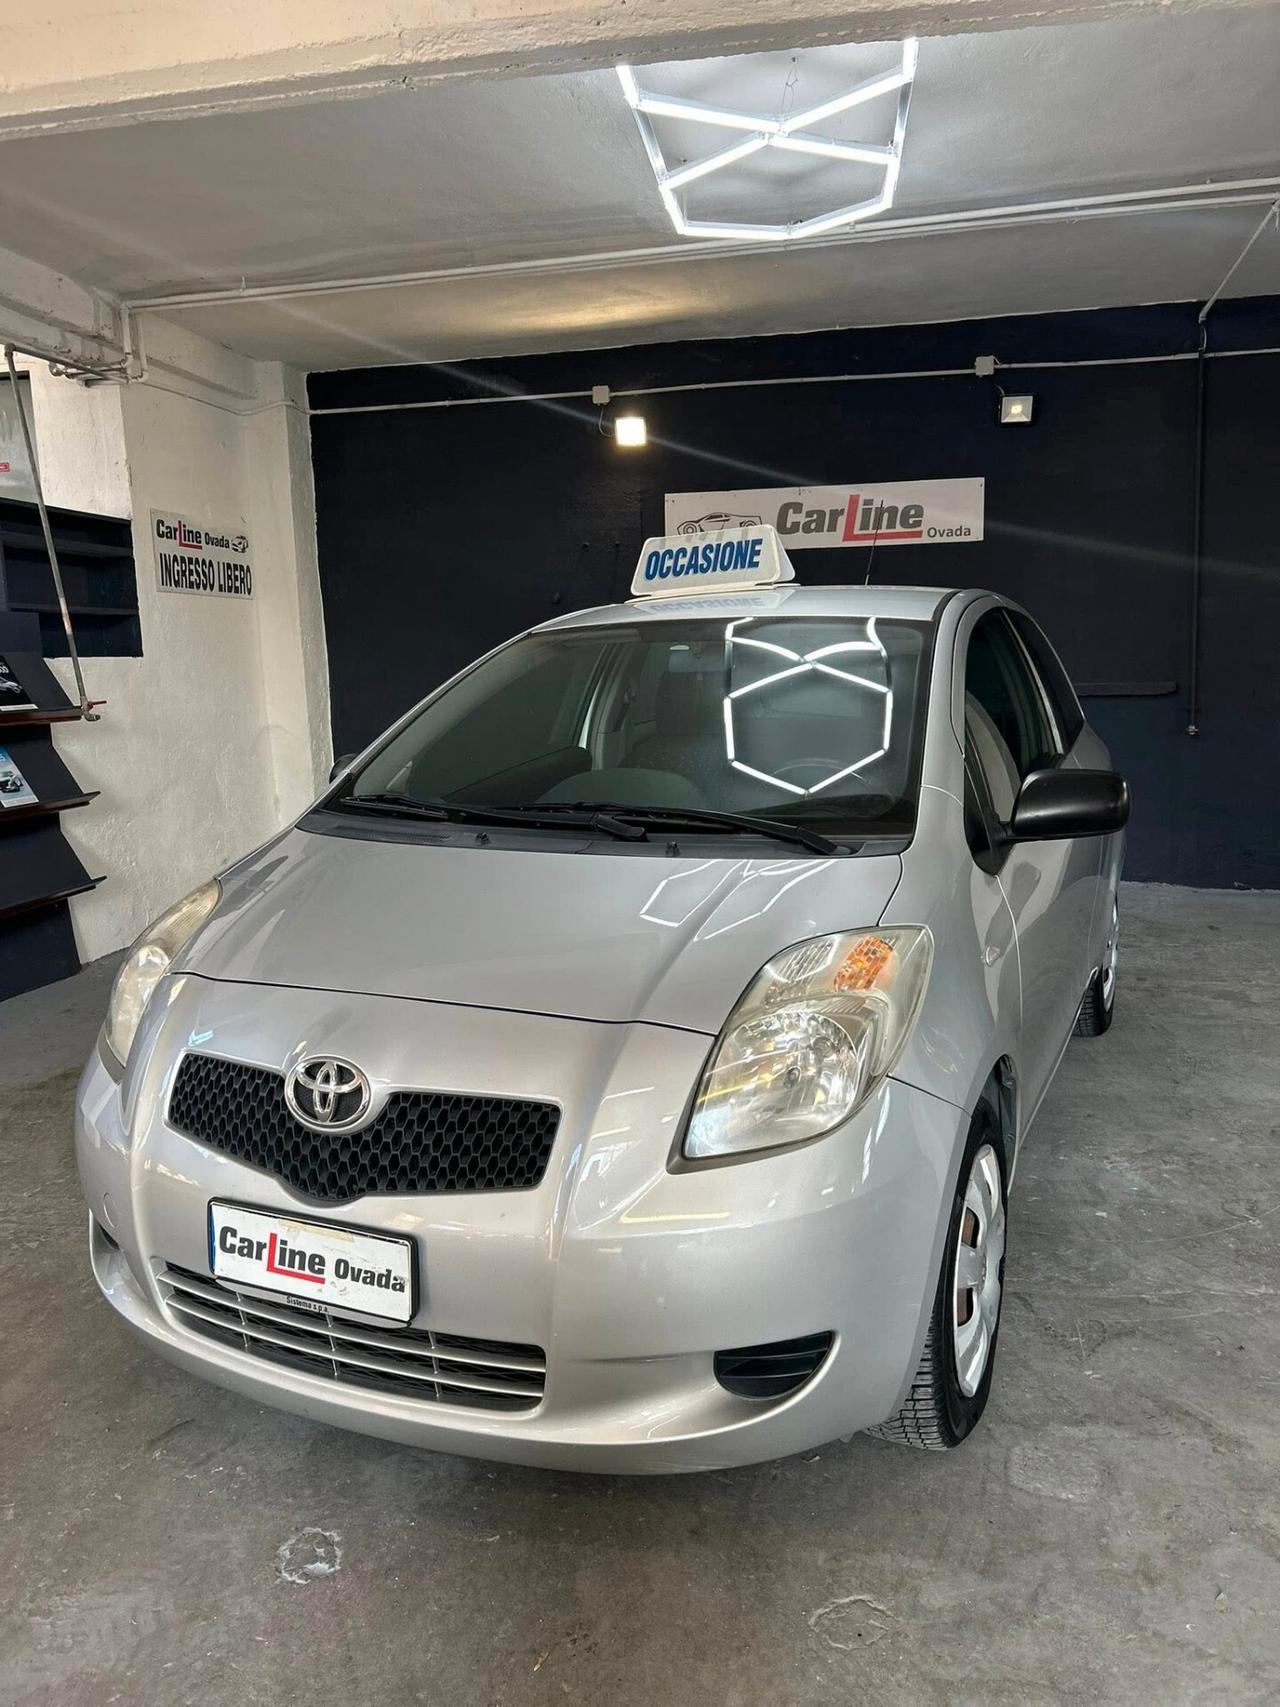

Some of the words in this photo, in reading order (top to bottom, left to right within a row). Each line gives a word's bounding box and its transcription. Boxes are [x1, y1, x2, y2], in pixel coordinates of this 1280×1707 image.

[157, 519, 203, 550] CarLine
[204, 532, 230, 549] Ovada
[776, 494, 924, 542] CarLine
[926, 525, 972, 538] Ovada
[160, 552, 215, 592] INGRESSO
[217, 561, 252, 595] LIBERO
[644, 538, 763, 581] OCCASIONE
[219, 1226, 326, 1285] CarLine
[334, 1258, 406, 1293] Ovada
